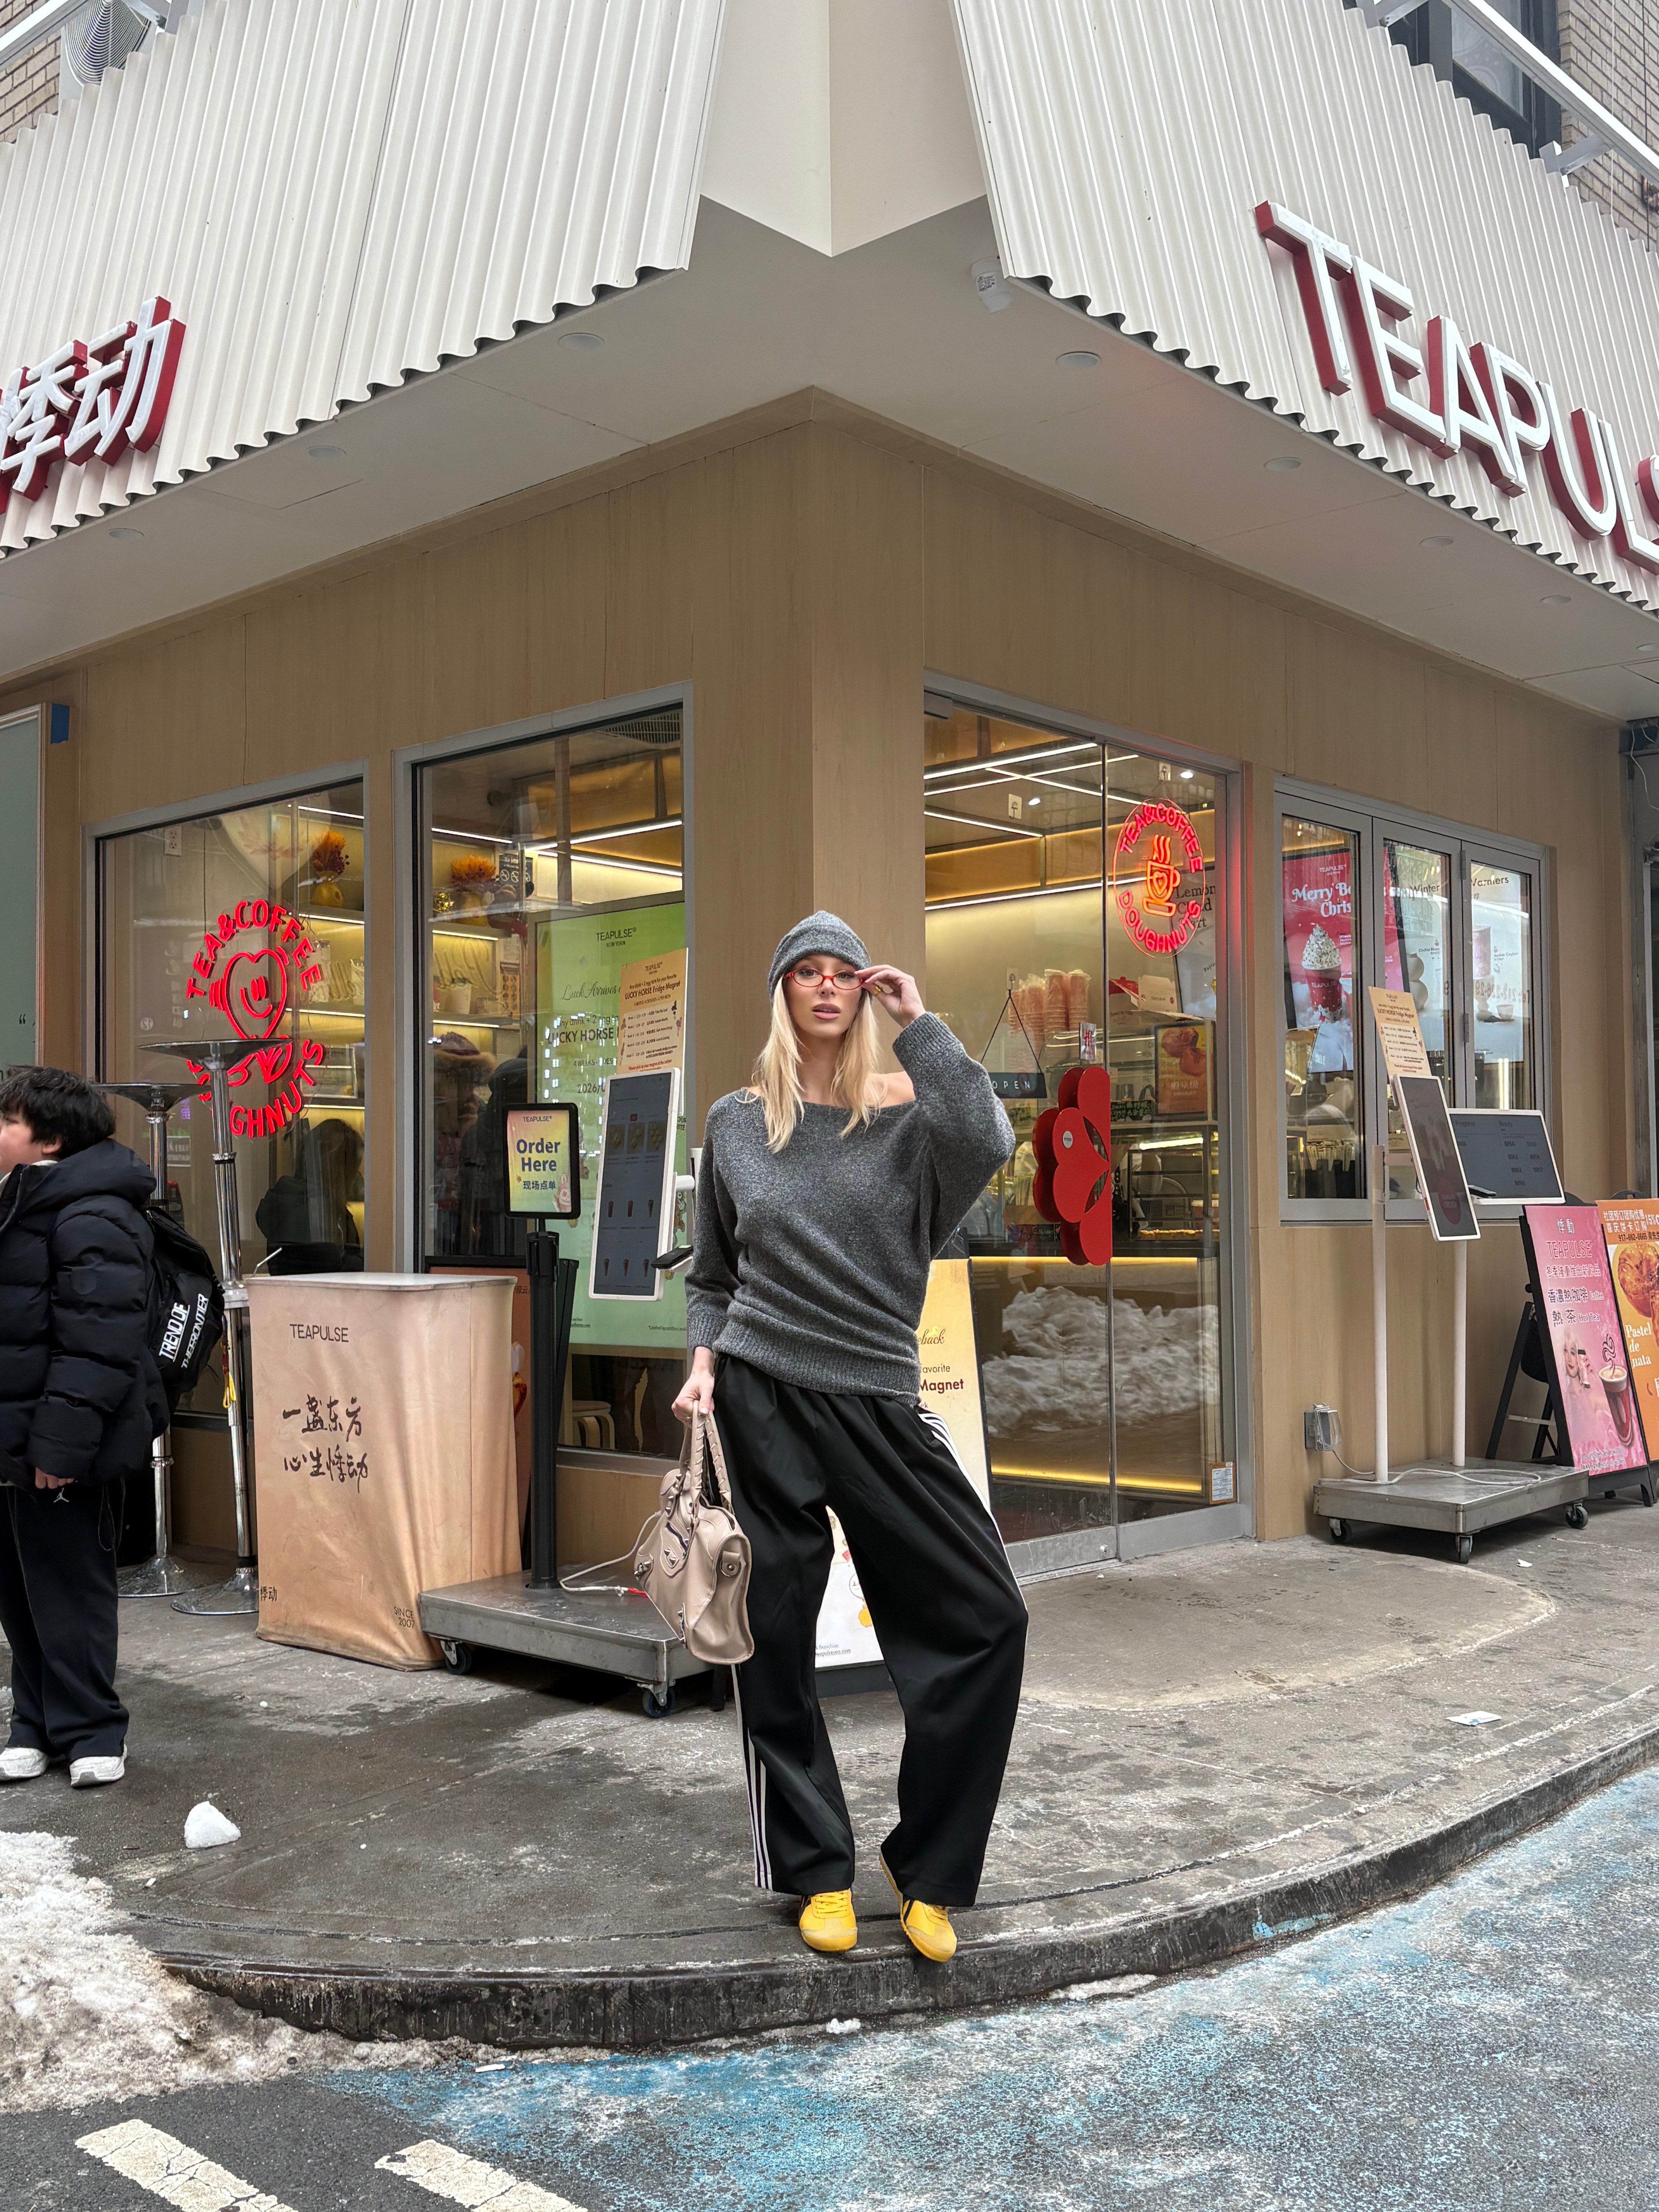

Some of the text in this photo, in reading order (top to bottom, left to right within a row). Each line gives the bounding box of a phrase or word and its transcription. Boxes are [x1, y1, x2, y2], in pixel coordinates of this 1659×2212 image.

[1255, 200, 1659, 575] TEAPUL
[1120, 803, 1203, 873] TEA&COFFEE
[1291, 884, 1333, 902] Merry
[1410, 884, 1440, 893] Winter
[1119, 890, 1200, 953] DOUGHNUTS
[186, 899, 321, 998] TEA&COFFEE
[547, 1030, 578, 1044] LUCKY
[581, 1027, 614, 1041] HORSE
[187, 1039, 325, 1138] GHNUTS
[992, 1081, 1030, 1089] OPEN
[517, 1138, 560, 1154] Order
[521, 1157, 556, 1172] Here
[523, 1180, 556, 1190] 现场点单
[1546, 1240, 1592, 1258] TEAPULSE
[159, 1302, 187, 1359] TREND OF
[290, 1324, 349, 1343] TEAPULSE
[1625, 1322, 1652, 1338] Pastel
[1629, 1339, 1639, 1353] de
[1631, 1355, 1652, 1369] nata
[394, 1606, 414, 1619] SINCE
[399, 1617, 415, 1628] 2007
